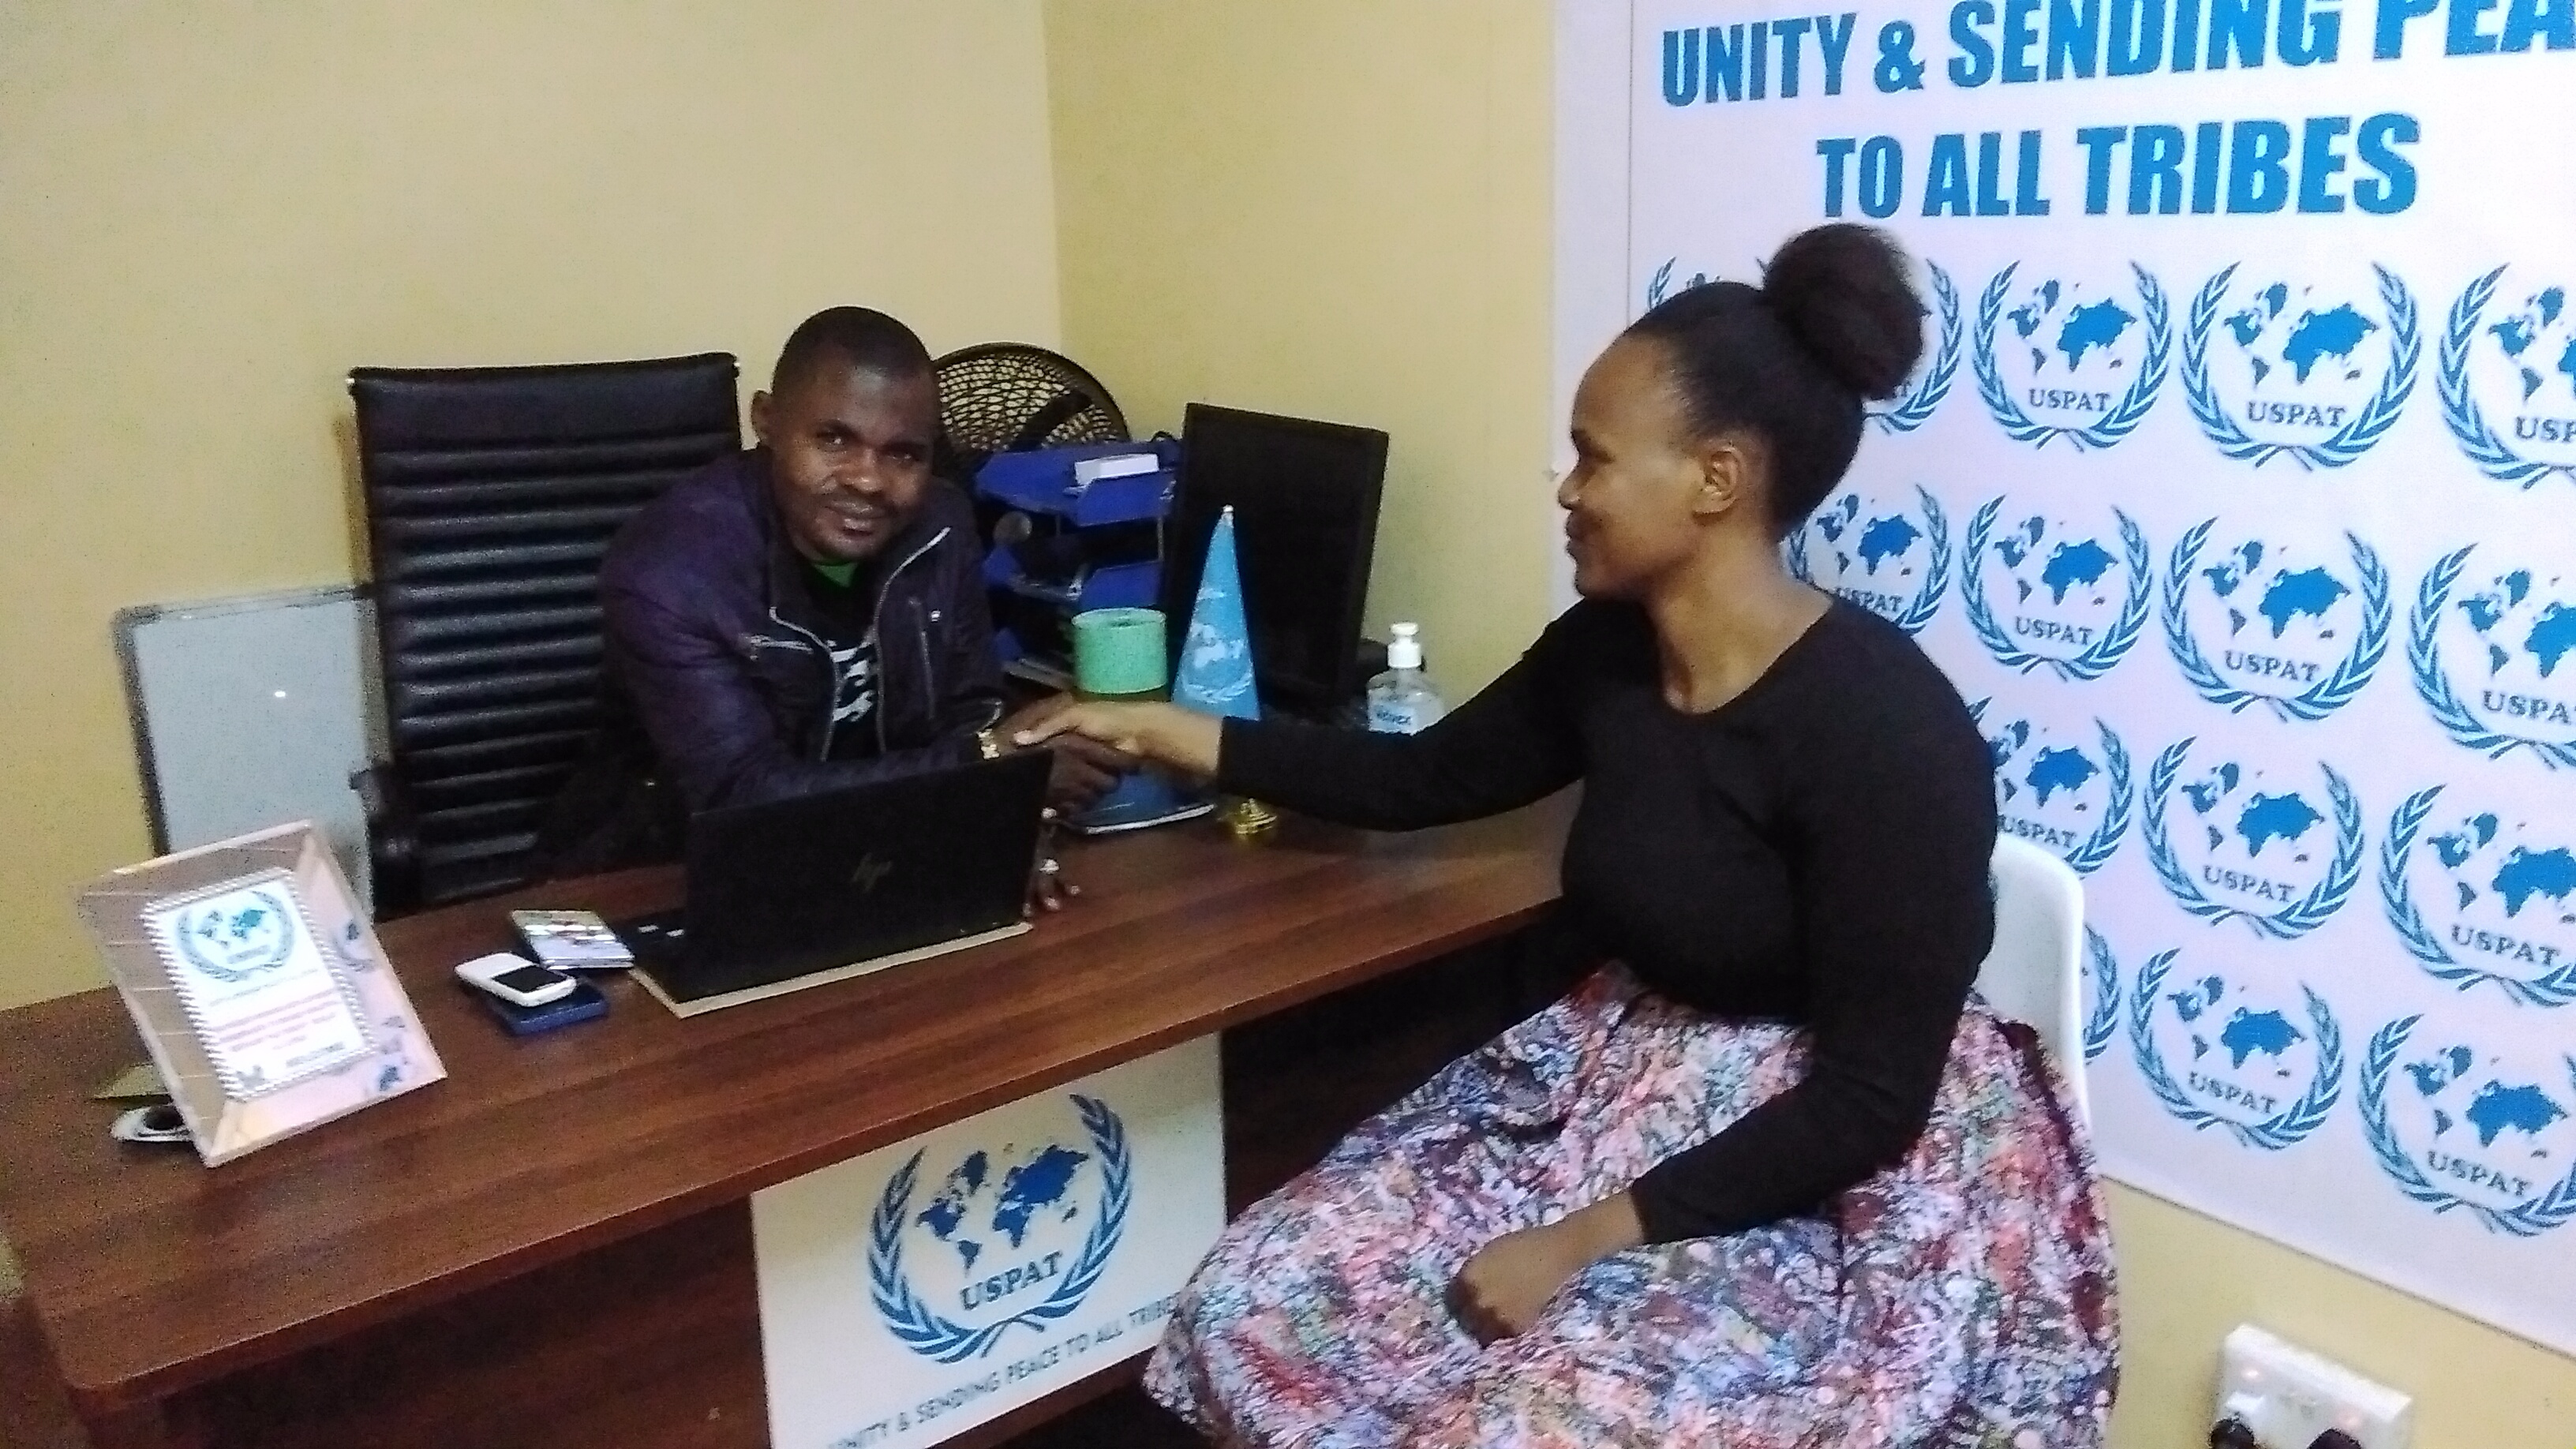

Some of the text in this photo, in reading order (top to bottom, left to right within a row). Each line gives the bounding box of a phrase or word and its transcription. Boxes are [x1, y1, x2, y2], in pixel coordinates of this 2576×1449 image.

[1662, 12, 1858, 107] UNITY
[1873, 20, 1926, 94] &
[1948, 0, 2342, 88] SENDING
[1816, 112, 2422, 219] TO ALL TRIBES
[2028, 388, 2111, 412] USPAT
[2247, 401, 2346, 427] USPAT
[2015, 616, 2092, 646] USPAT
[2225, 650, 2320, 682] USPAT
[2483, 691, 2576, 725] USPA
[1998, 814, 2078, 848] USPAT
[2203, 866, 2295, 903] USPAT
[2451, 925, 2559, 966] USPAT
[2187, 1071, 2278, 1114] USPAT
[2427, 1150, 2531, 1196] USPAT
[960, 1249, 1062, 1311] USPAT
